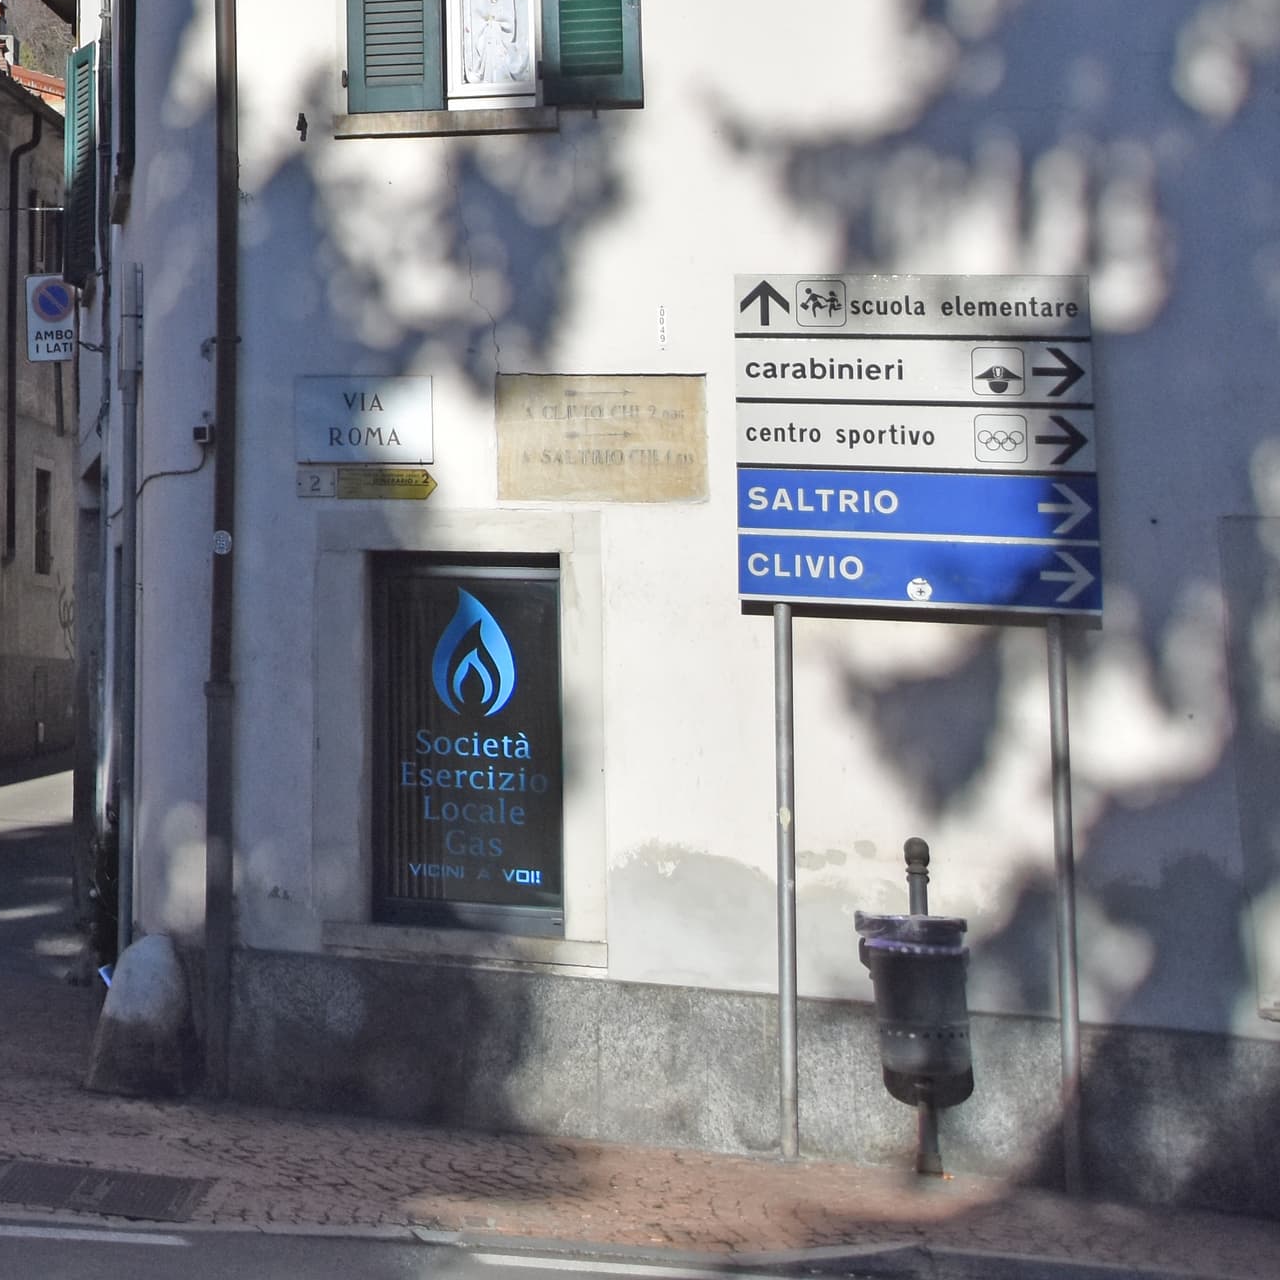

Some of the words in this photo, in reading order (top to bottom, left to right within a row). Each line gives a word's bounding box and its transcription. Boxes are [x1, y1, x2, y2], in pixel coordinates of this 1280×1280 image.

[850, 295, 926, 317] scuola
[940, 296, 1079, 318] elementare
[35, 329, 73, 341] AMBO
[46, 342, 73, 353] LATI
[744, 358, 905, 381] carabinieri
[343, 392, 384, 412] VIA
[328, 426, 402, 447] ROMA
[745, 423, 822, 444] centro
[835, 424, 936, 450] sportivo
[310, 474, 321, 492] 2
[421, 473, 430, 484] 2
[747, 486, 900, 515] SALTRIO
[747, 552, 864, 581] CLIVIO
[415, 729, 532, 759] Società
[400, 761, 549, 793] Esercizio
[423, 795, 526, 825] Locale
[445, 829, 504, 857] Gas
[409, 863, 465, 879] VICINI
[503, 868, 543, 885] VOI!
